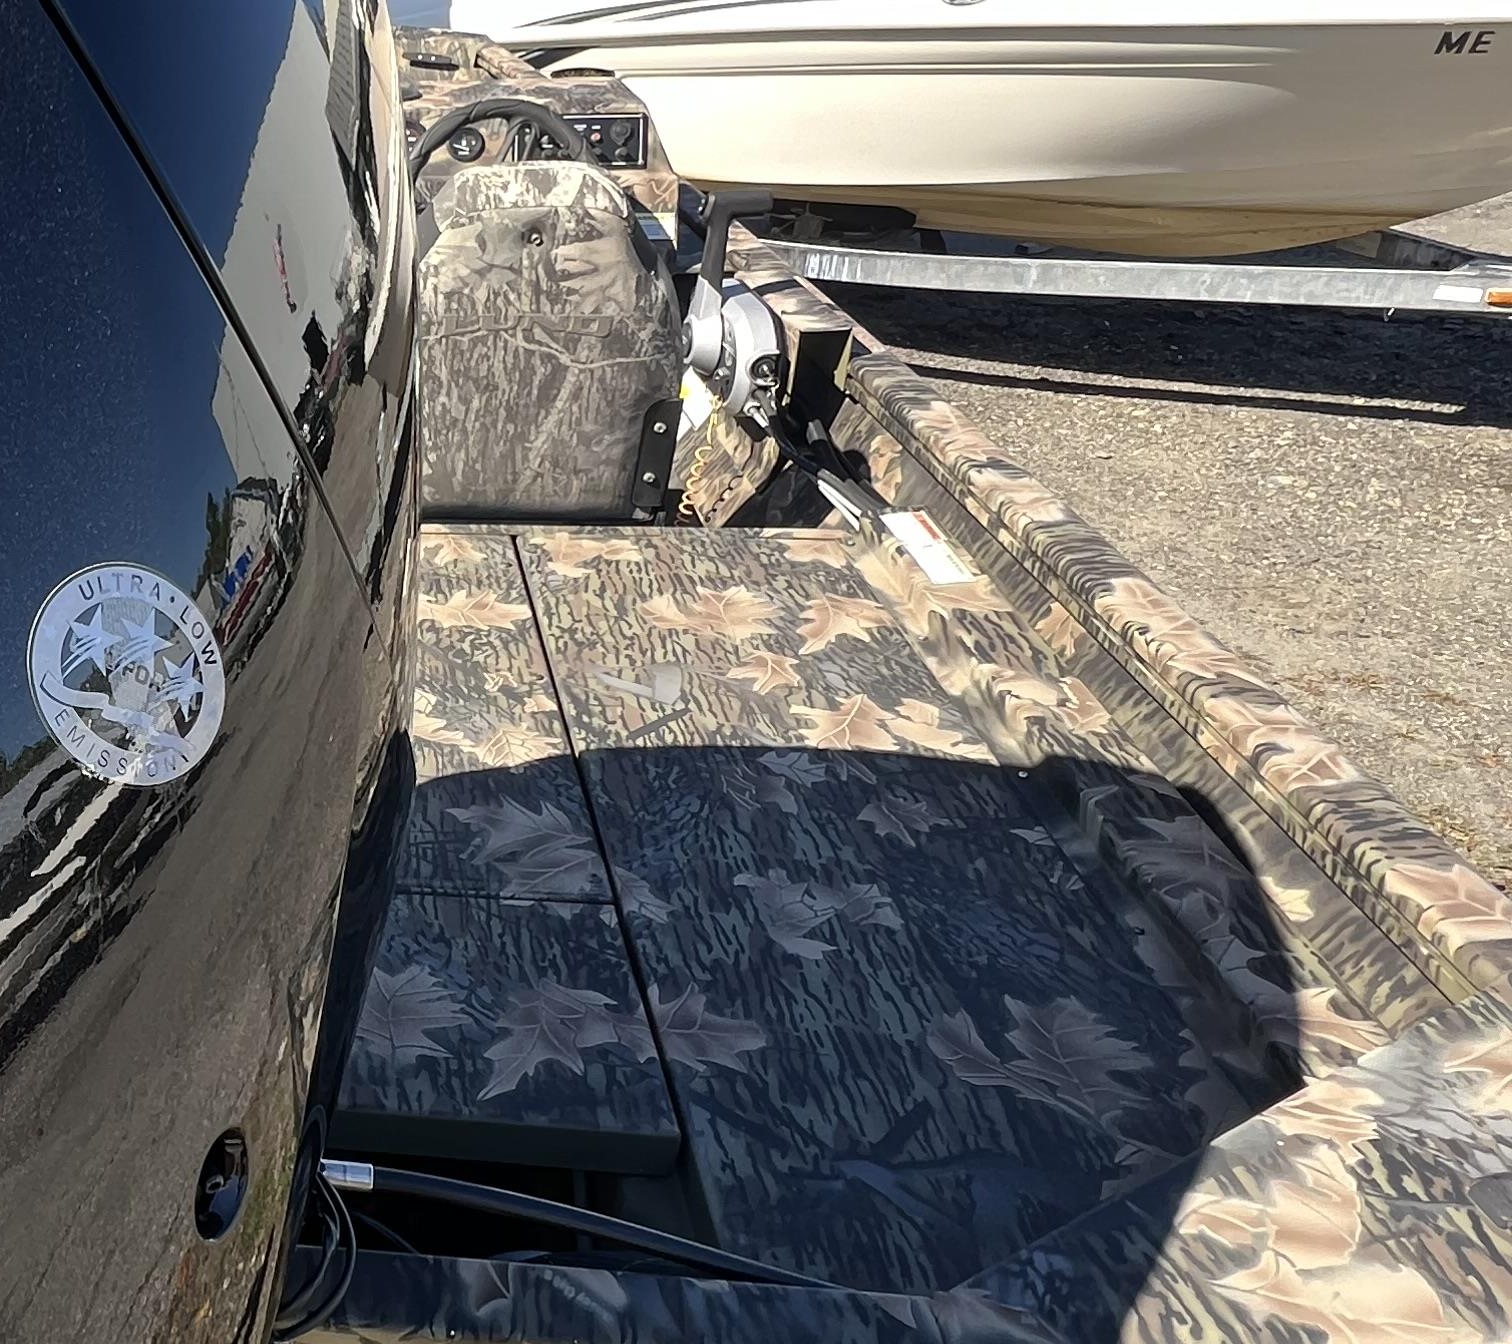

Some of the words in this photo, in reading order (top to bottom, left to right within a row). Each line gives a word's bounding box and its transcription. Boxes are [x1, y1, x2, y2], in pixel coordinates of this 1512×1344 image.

[1433, 30, 1497, 55] ME
[78, 572, 162, 602] ULTRA
[179, 605, 218, 666] LOW
[54, 708, 178, 778] EMISSON
